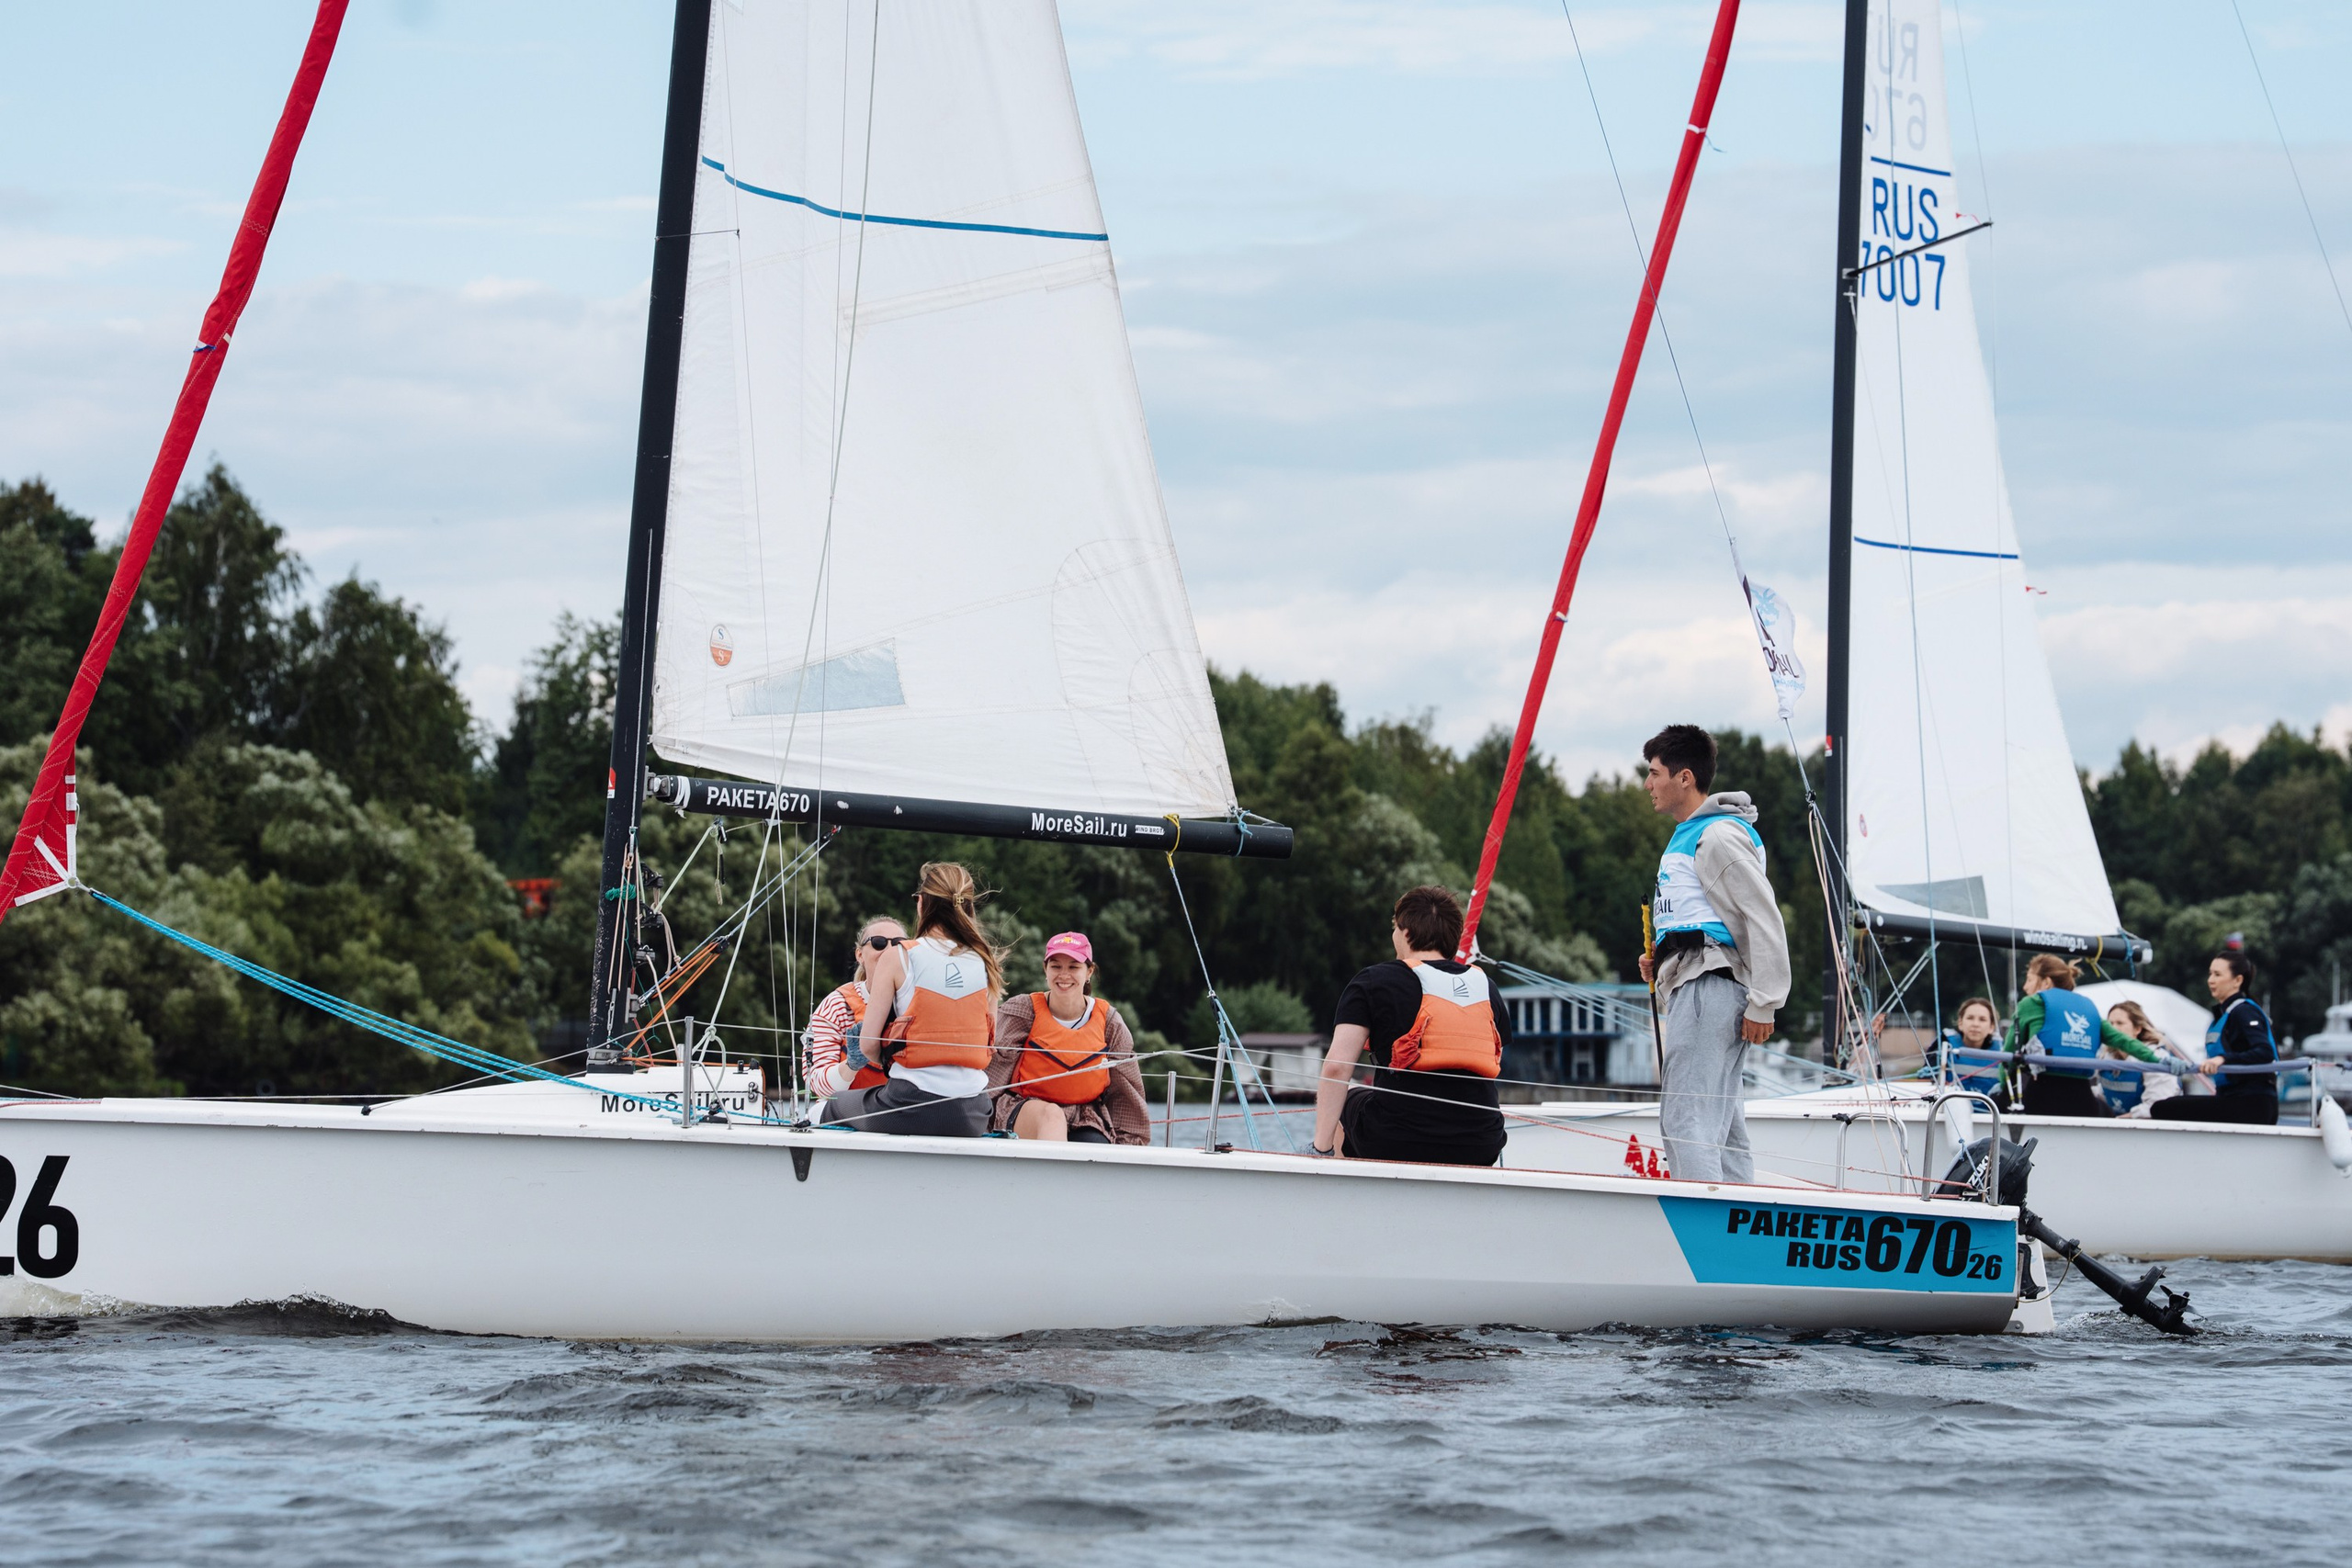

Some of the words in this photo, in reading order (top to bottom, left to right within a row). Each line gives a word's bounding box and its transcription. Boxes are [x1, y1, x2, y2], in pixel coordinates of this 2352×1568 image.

[1871, 176, 1939, 244] RUS
[1031, 812, 1127, 838] MoreSail.ru
[0, 1155, 79, 1279] 6
[1864, 1215, 1973, 1278] 670
[1966, 1253, 2004, 1280] 26
[1786, 1241, 1862, 1271] RUS
